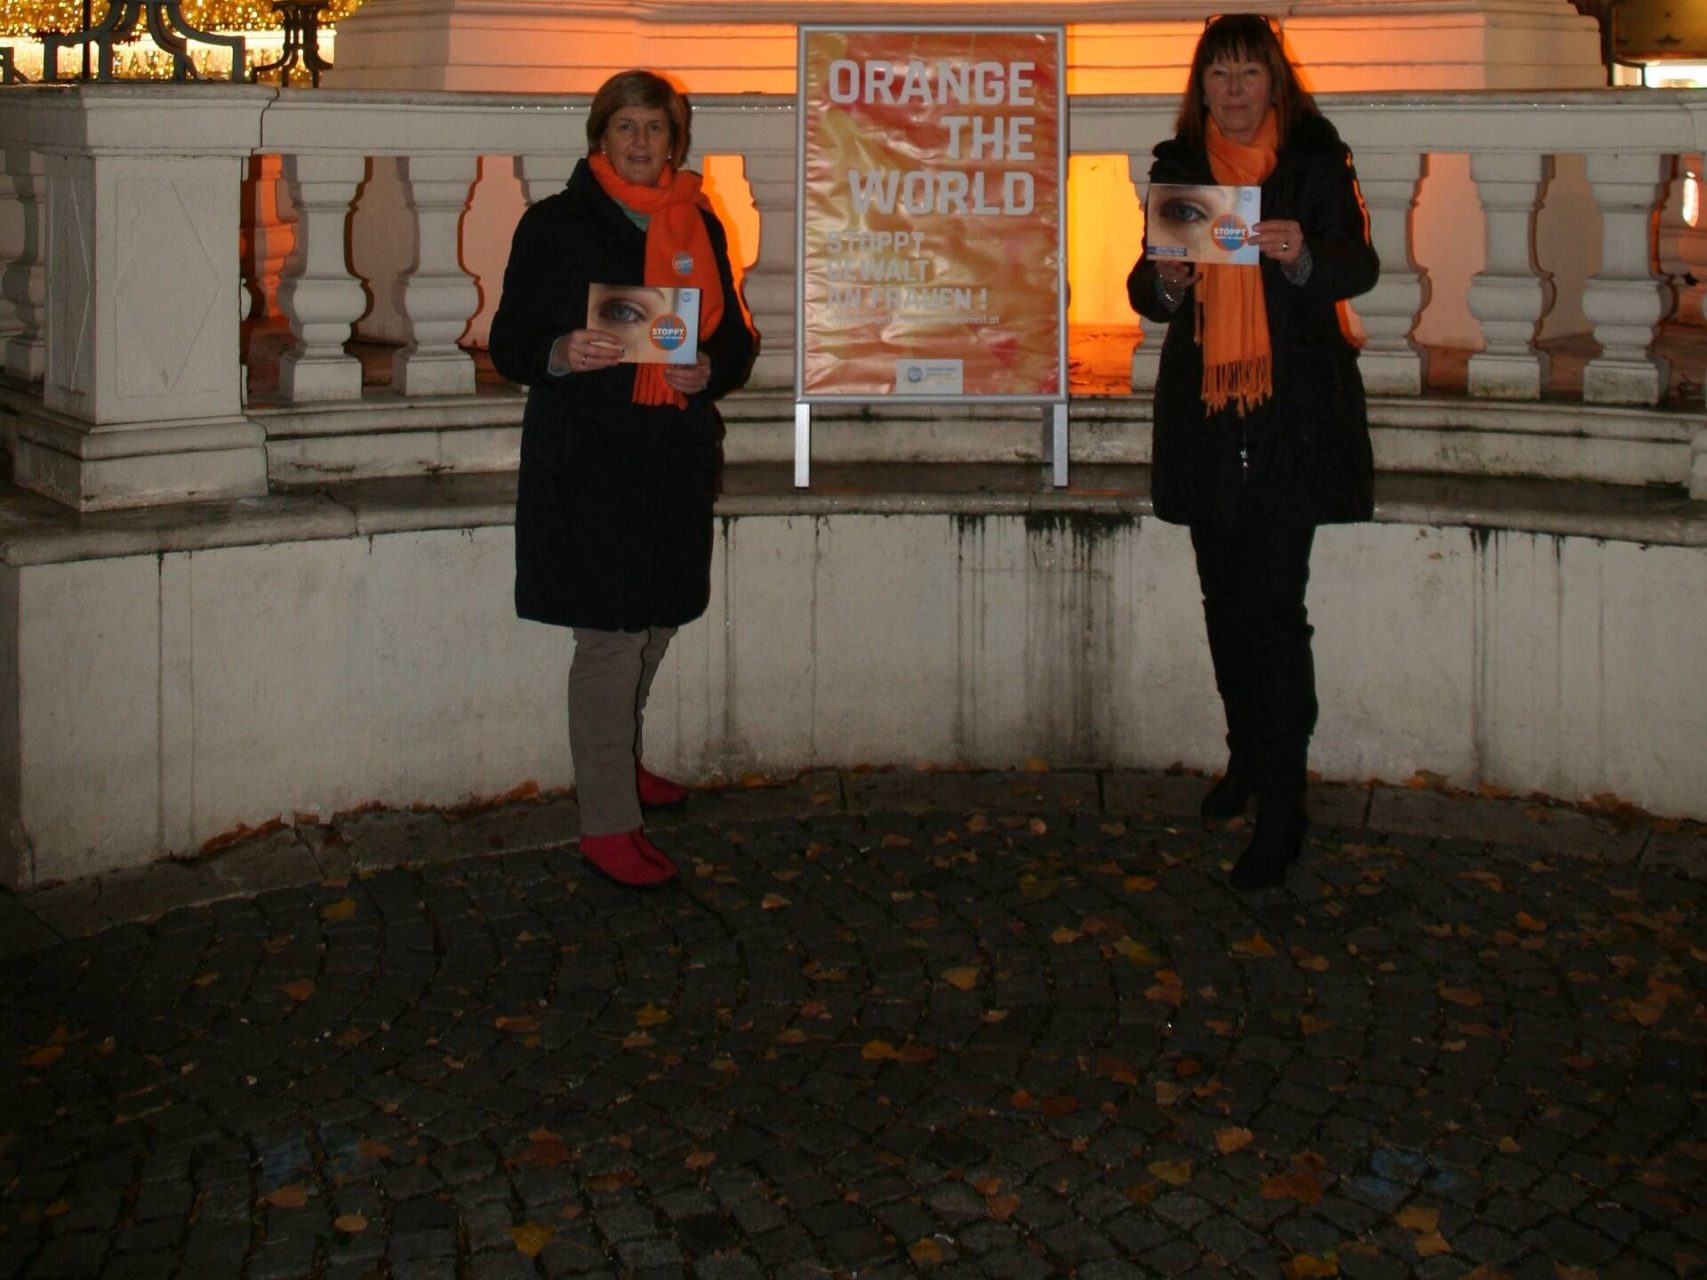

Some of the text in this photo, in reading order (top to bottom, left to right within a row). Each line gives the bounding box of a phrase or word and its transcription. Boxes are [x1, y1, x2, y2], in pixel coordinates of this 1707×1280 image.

[828, 59, 1036, 106] ORANGE
[941, 116, 1036, 162] THE
[848, 170, 1036, 217] WORLD
[826, 231, 925, 255] STOPPT
[1213, 227, 1246, 236] STOPPT
[826, 259, 930, 282] GEWALT
[826, 287, 862, 310] AN
[870, 287, 972, 310] FRAUEN
[652, 328, 685, 336] STOPPT
